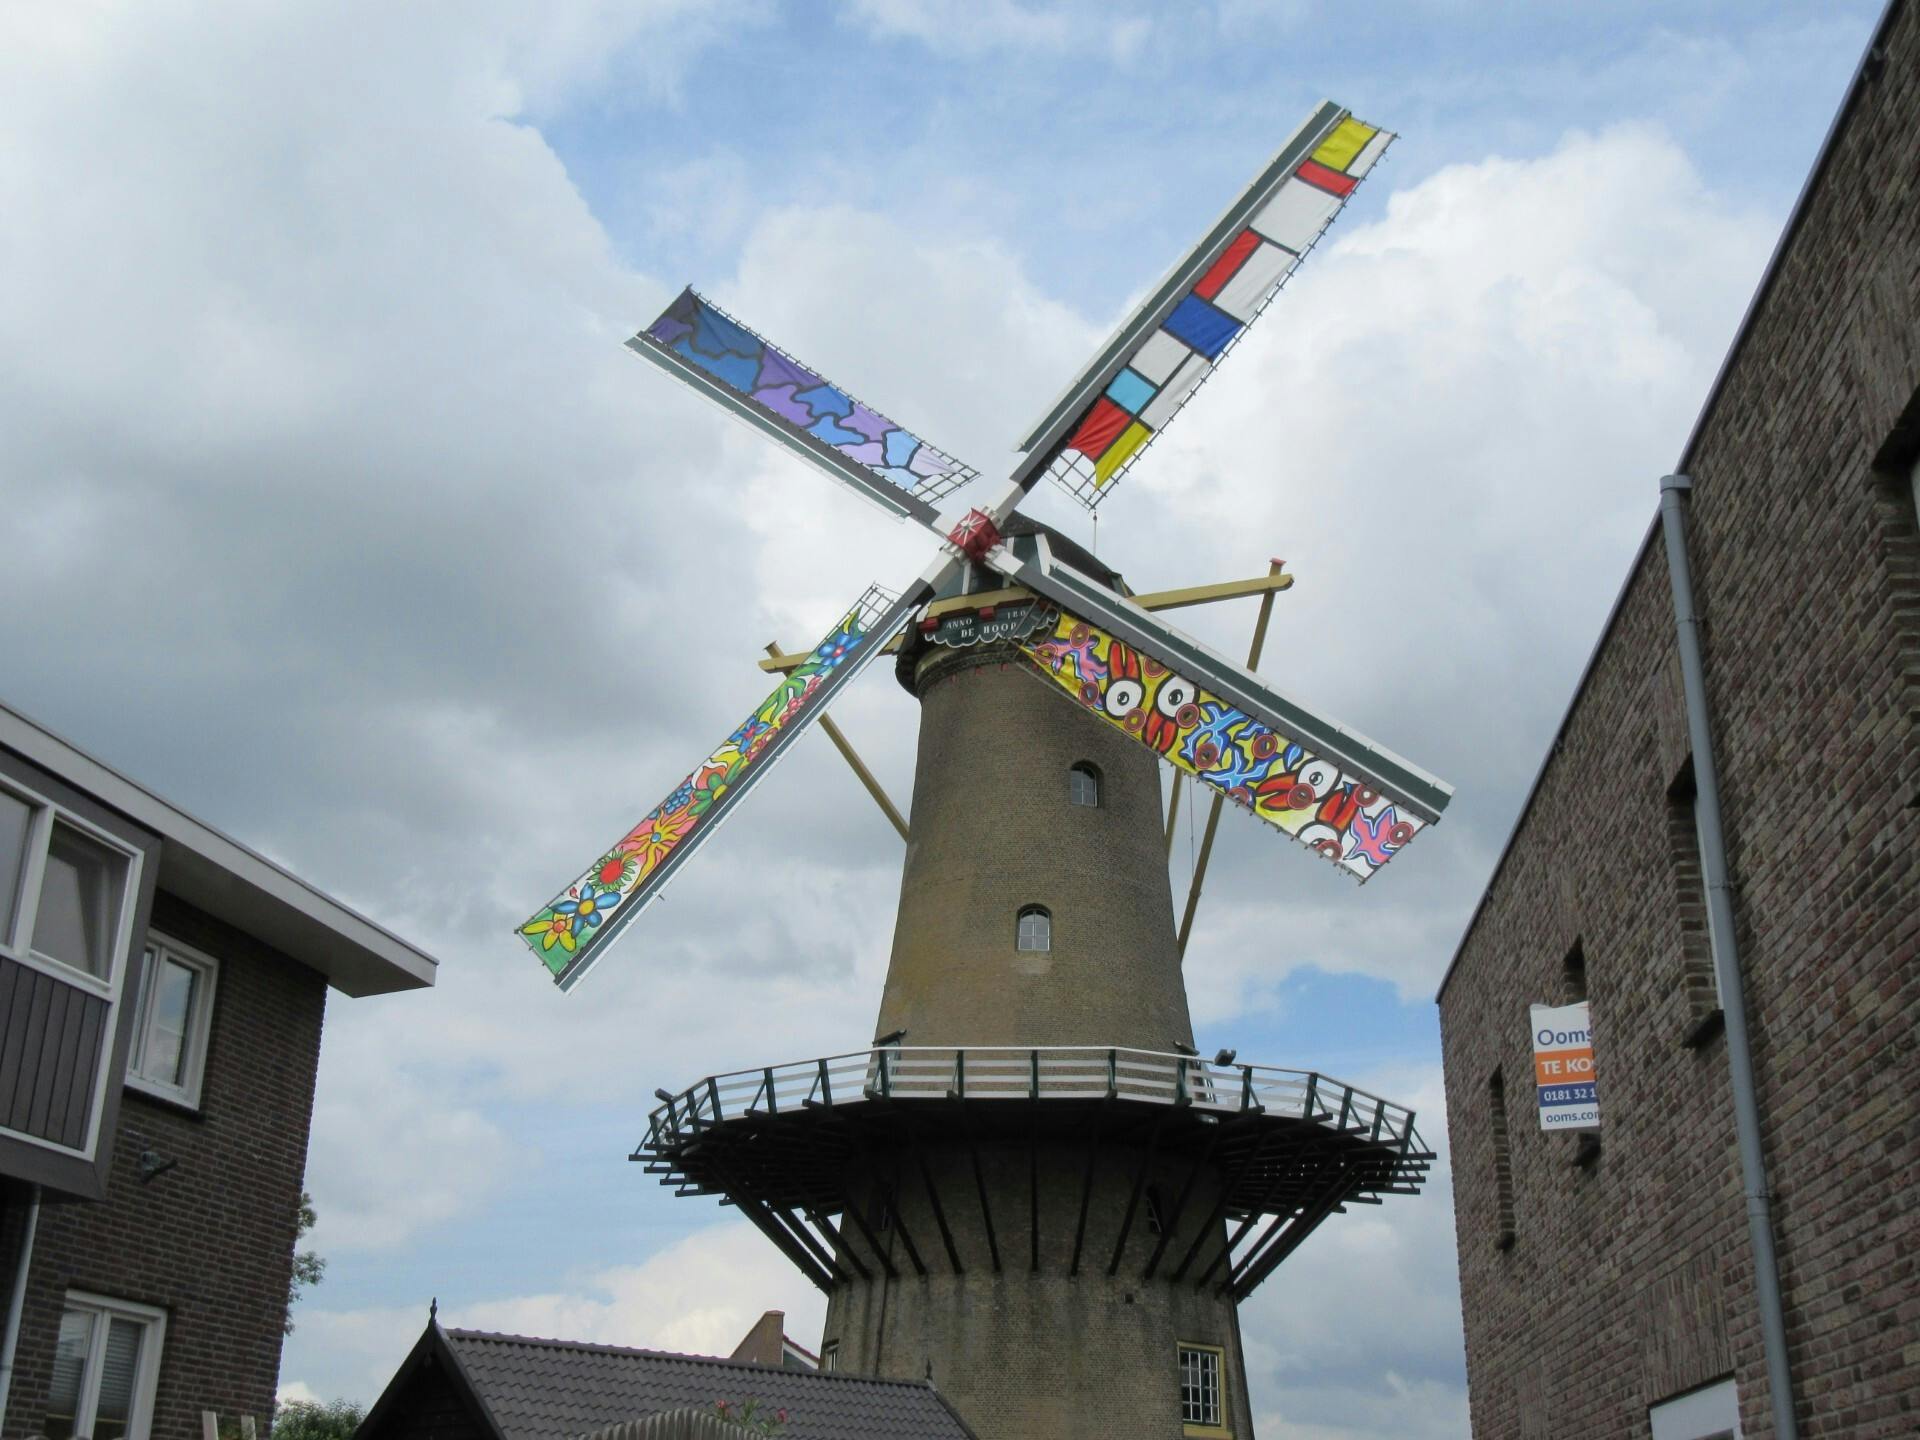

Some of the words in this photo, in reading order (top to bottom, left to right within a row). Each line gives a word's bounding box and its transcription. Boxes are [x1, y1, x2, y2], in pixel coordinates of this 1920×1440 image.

[946, 618, 972, 630] ANNO
[961, 629, 975, 638] DE
[983, 623, 1016, 634] HOOP
[1538, 1029, 1592, 1046] Ooms
[1542, 1060, 1561, 1074] TE
[1567, 1057, 1595, 1073] KO
[1544, 1091, 1572, 1101] 0181
[1574, 1088, 1588, 1099] 32
